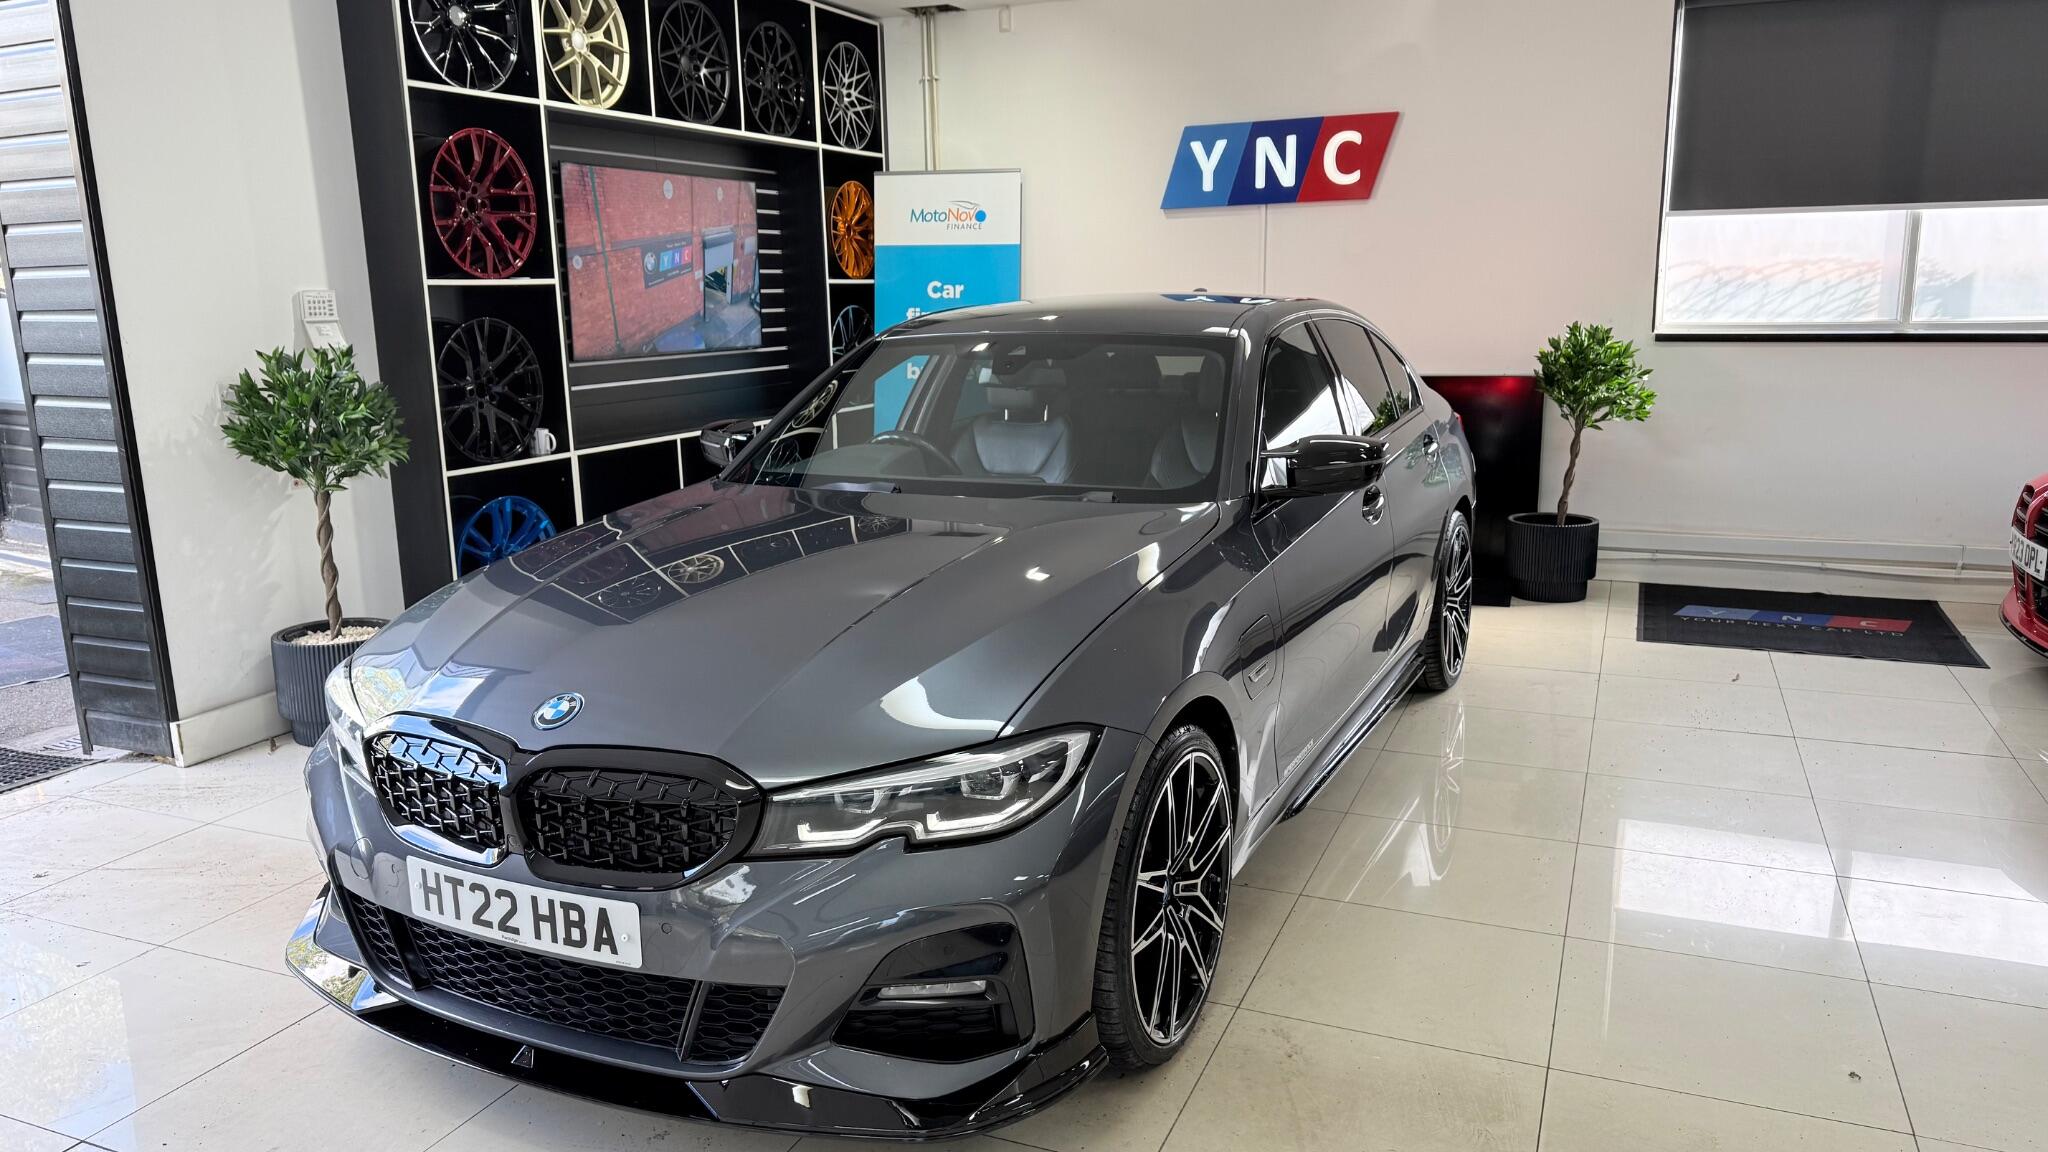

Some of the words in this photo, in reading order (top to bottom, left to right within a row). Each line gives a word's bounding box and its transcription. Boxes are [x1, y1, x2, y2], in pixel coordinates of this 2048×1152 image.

[1189, 130, 1363, 192] YNC
[946, 222, 983, 231] FINANCE
[927, 280, 965, 299] Car
[420, 867, 521, 936] HT22
[530, 894, 619, 956] HBA
